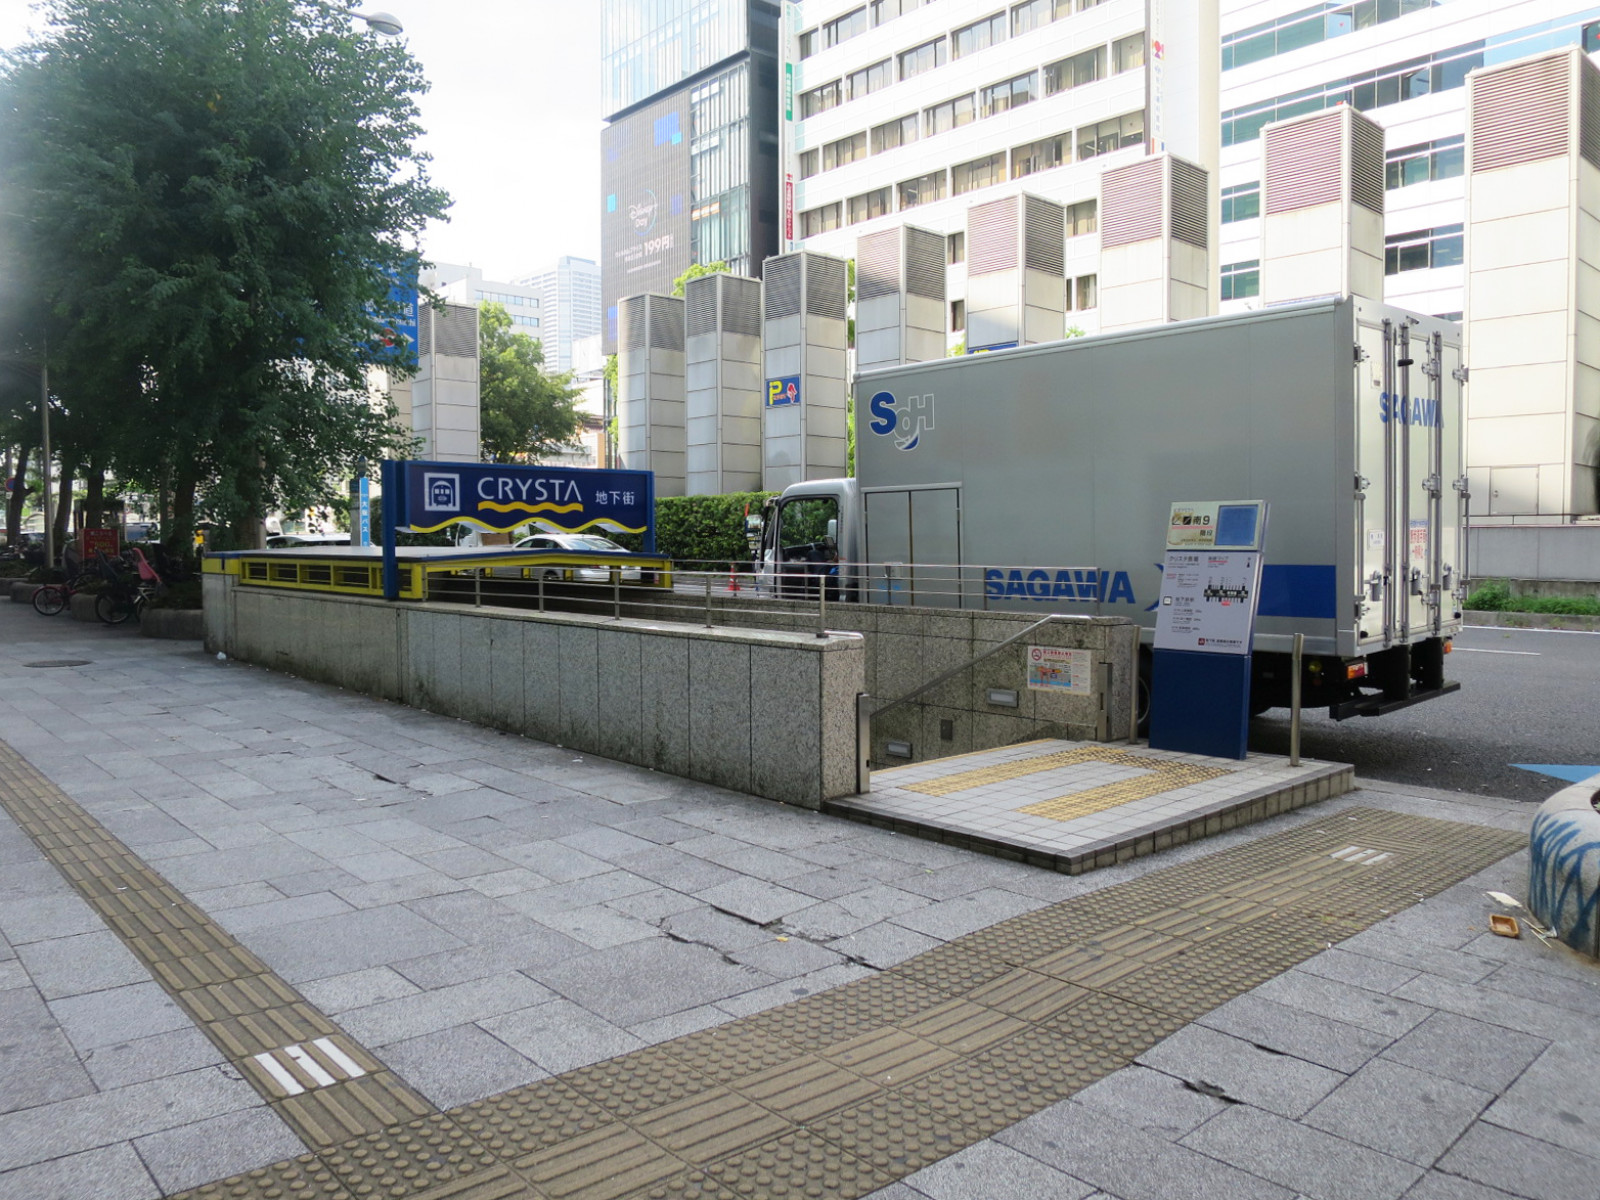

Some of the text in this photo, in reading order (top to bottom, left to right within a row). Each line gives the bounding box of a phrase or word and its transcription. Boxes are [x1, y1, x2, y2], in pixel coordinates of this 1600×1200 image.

[769, 380, 783, 405] P
[478, 477, 635, 506] CRYSTA 地下街
[986, 569, 1136, 604] SAGAWA
